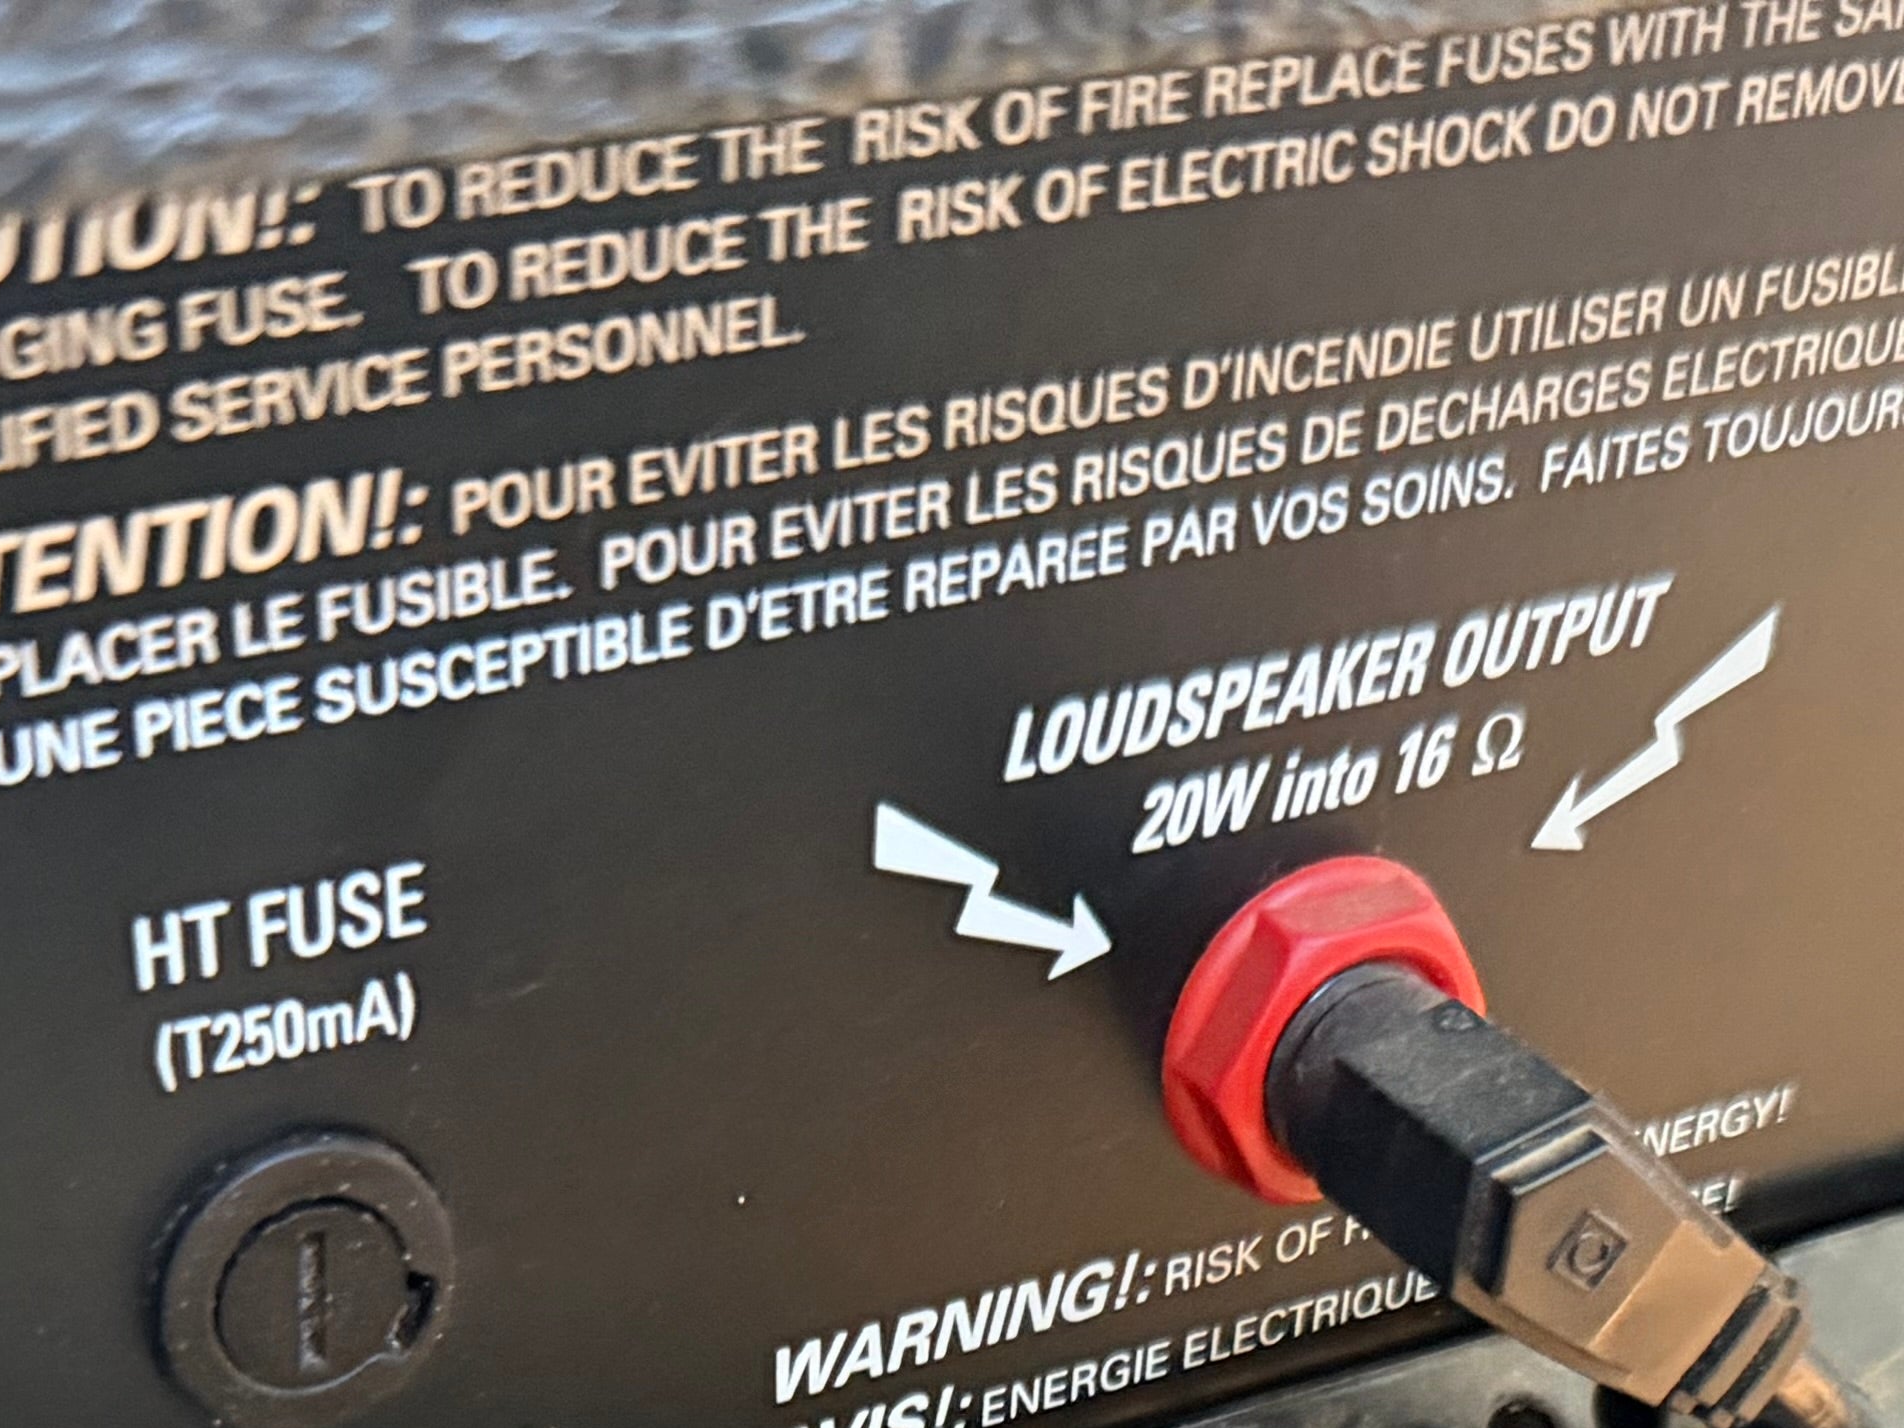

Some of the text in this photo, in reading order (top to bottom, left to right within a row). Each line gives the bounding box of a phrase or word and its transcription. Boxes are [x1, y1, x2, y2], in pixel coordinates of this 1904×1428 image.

[179, 271, 363, 351] FUSE.
[407, 249, 498, 314] TO
[510, 213, 748, 300] REDUCE
[757, 196, 871, 262] THE
[898, 174, 1023, 243] RISK
[1034, 162, 1110, 223] OF
[1118, 128, 1357, 212] ELECTRIC
[1366, 102, 1536, 177] SHOCK
[1545, 94, 1617, 153] DO
[1626, 78, 1731, 141] NOT
[352, 168, 445, 234] TO
[456, 133, 699, 220] REDUCE
[711, 113, 826, 183] THE
[851, 96, 982, 166] RISK
[992, 85, 1069, 146] OF
[1078, 70, 1192, 135] FIRE
[1203, 38, 1427, 118] REPLACE
[1437, 18, 1595, 88] FUSES
[1609, 3, 1724, 67] WITH
[1741, 0, 1824, 50] THE
[170, 347, 430, 442] SERVICE
[443, 294, 806, 398] PERSONNEL.
[452, 457, 615, 535] POUR
[628, 423, 819, 505] EVITER
[833, 403, 931, 470] LES
[944, 364, 1170, 450] RISQUES
[1182, 318, 1456, 410] D'INCENDIE
[1469, 284, 1668, 362] UTILISER
[1678, 271, 1747, 328] UN
[133, 675, 303, 759] PIECE
[315, 603, 693, 724] SUSCEPTIBLE
[706, 567, 891, 651] D'ETRE
[903, 523, 1130, 613] REPAREE
[1141, 502, 1238, 567] PAR
[1251, 482, 1350, 546] VOS
[1360, 453, 1514, 526] SOINS.
[1540, 420, 1691, 493] FAITES
[232, 592, 306, 658] LE
[317, 548, 573, 642] FUSIBLE.
[601, 513, 757, 591] POUR
[770, 479, 951, 560] EVITER
[965, 460, 1059, 525] LES
[1071, 420, 1288, 505] RISQUES
[1300, 407, 1365, 465] DE
[1375, 357, 1653, 452] DECHARGES
[1003, 575, 1674, 782] LOUDSPEAKER OUTPUT
[1131, 710, 1525, 854] 20W into 16 Ω
[132, 861, 427, 991] HT FUSE
[156, 971, 416, 1093] (T250mA)
[775, 1250, 1158, 1404] WARNING!:
[1164, 1235, 1263, 1296] RISK
[1275, 1215, 1334, 1264] OF
[1636, 1085, 1795, 1157] NERGY!
[981, 1339, 1172, 1428] ENERGIE
